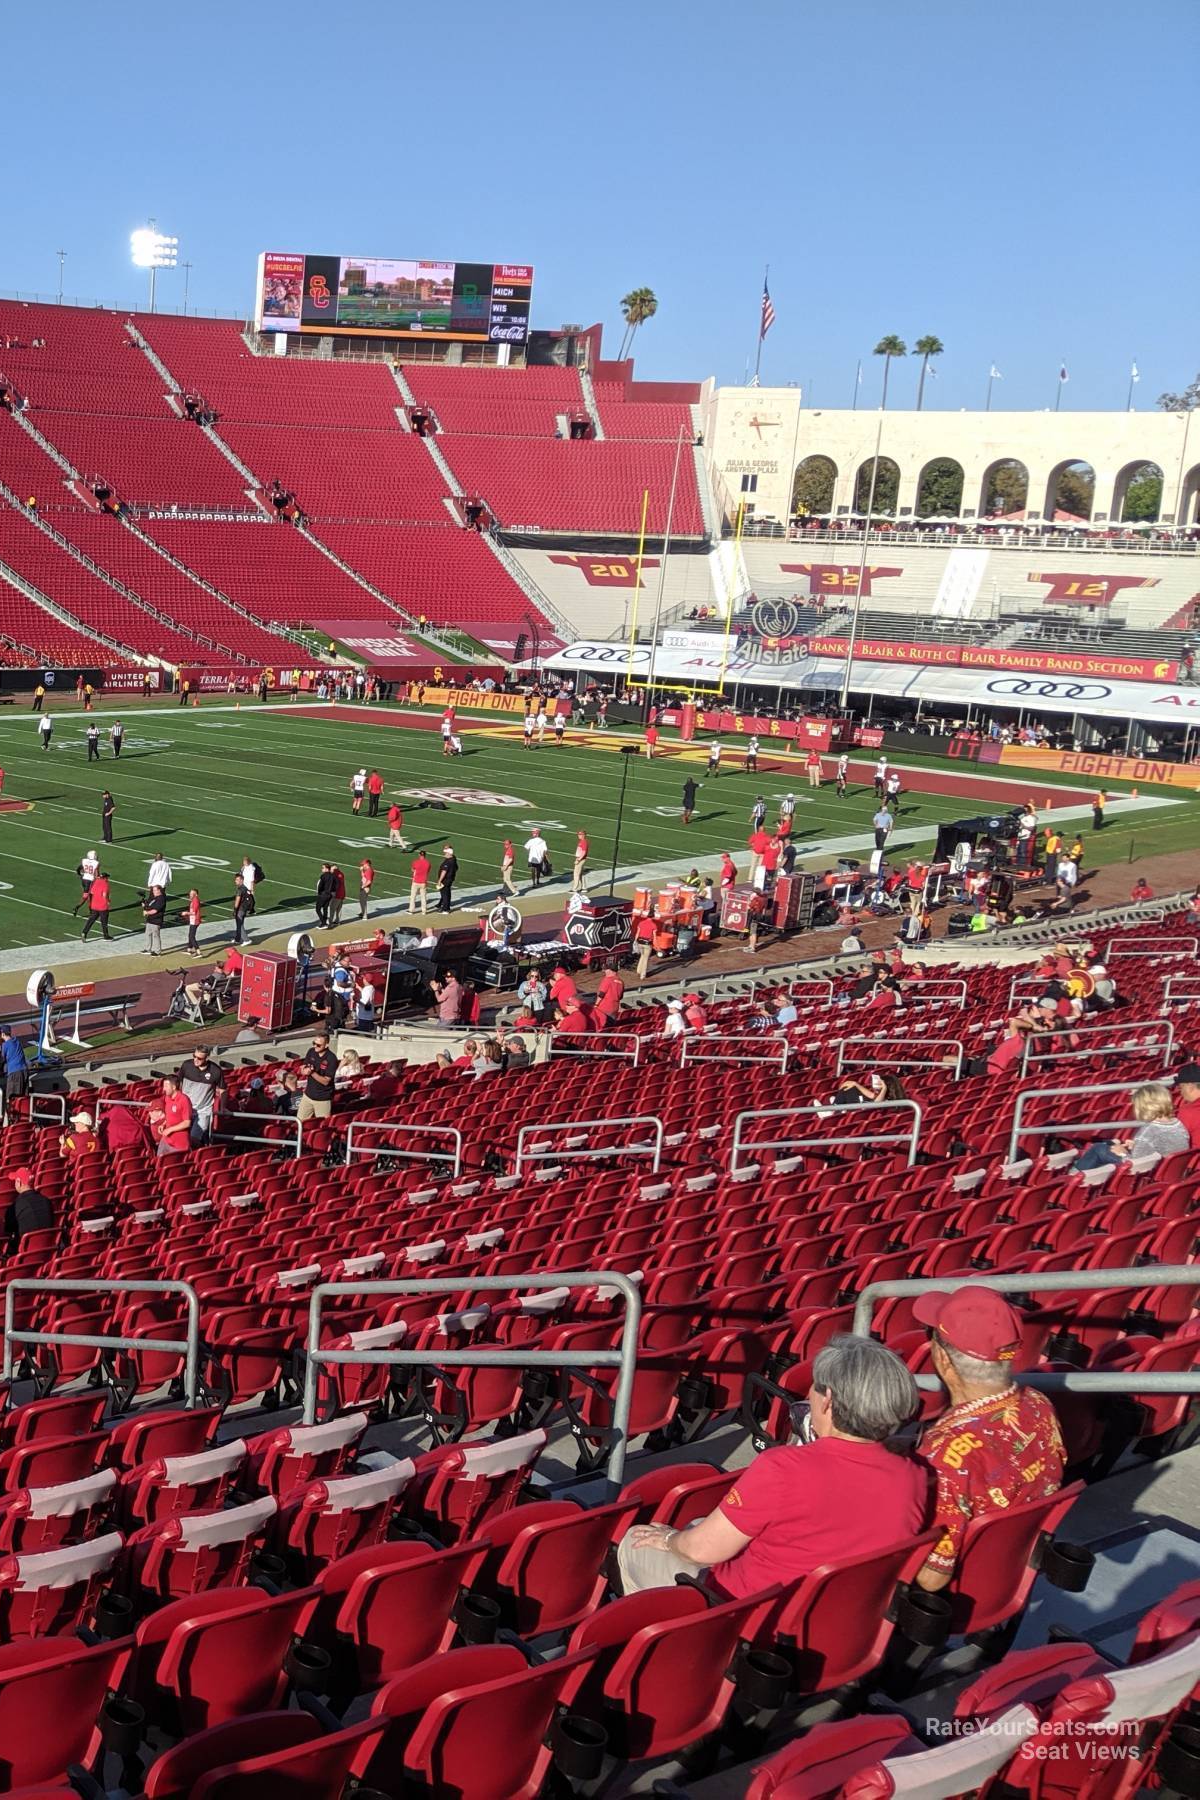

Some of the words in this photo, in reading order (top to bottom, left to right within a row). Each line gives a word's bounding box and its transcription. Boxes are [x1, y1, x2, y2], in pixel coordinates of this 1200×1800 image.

[494, 288, 513, 296] MICH
[493, 304, 507, 312] WIS
[590, 564, 628, 578] 20
[821, 573, 859, 586] 32
[1065, 582, 1105, 595] 12
[338, 637, 414, 648] MUSCLE
[365, 647, 419, 656] MILK
[736, 640, 809, 666] Allstate
[809, 640, 845, 653] FRANK
[862, 645, 893, 657] BLAIR
[896, 648, 906, 658] &
[909, 648, 942, 660] RUTH
[946, 650, 957, 661] C.
[961, 651, 996, 665] BLAIR
[1000, 653, 1044, 669] FAMILY
[1046, 655, 1084, 671] BAND
[1087, 659, 1144, 676] SECTION
[111, 673, 144, 681] UNITED
[447, 690, 491, 708] FIGHT
[491, 694, 516, 711] ON!
[1060, 753, 1128, 779] FIGHT
[1133, 759, 1175, 782] ON!
[83, 864, 94, 874] 28
[56, 987, 83, 996] ATORADE
[425, 1414, 433, 1423] 23
[572, 1425, 581, 1436] 24
[755, 1438, 766, 1450] 25
[942, 1432, 984, 1469] USC
